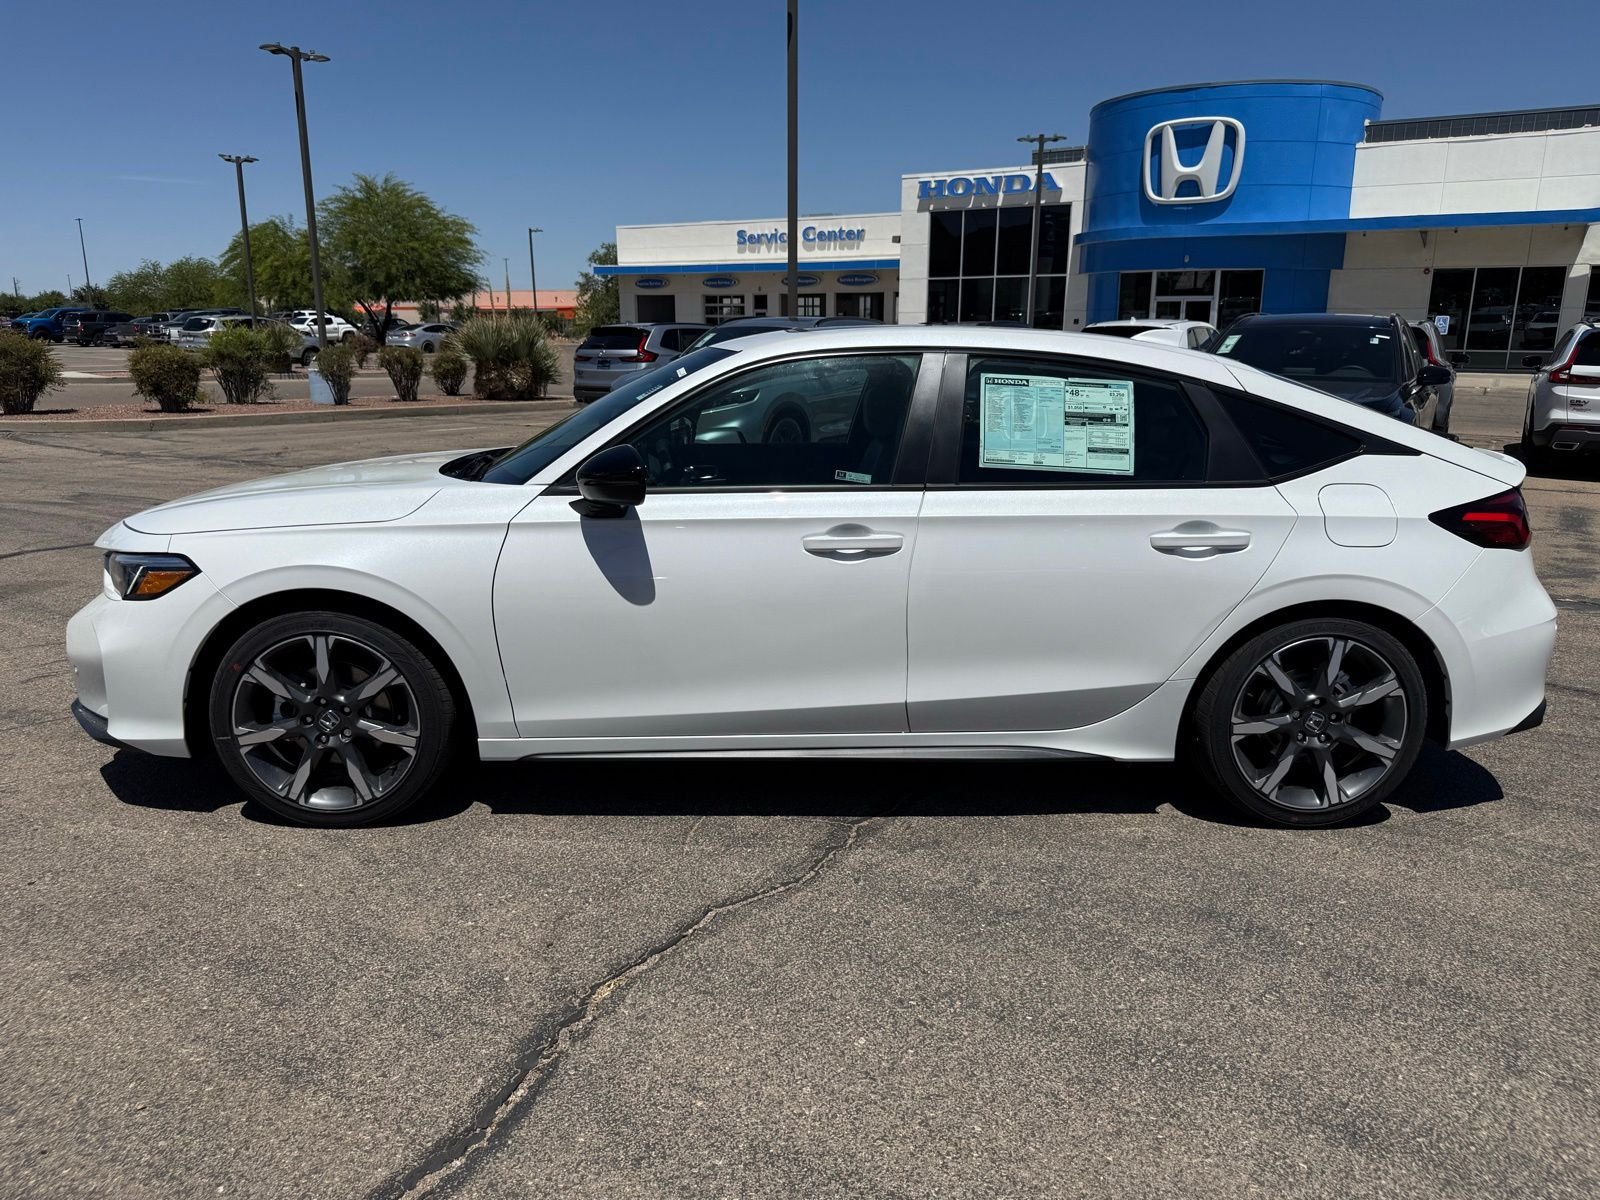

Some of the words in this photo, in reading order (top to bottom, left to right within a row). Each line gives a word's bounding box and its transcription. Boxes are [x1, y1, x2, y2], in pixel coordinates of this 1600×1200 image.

[918, 172, 1062, 199] HONDA
[737, 228, 789, 245] Servic
[802, 226, 865, 242] Center
[1069, 389, 1080, 397] 48
